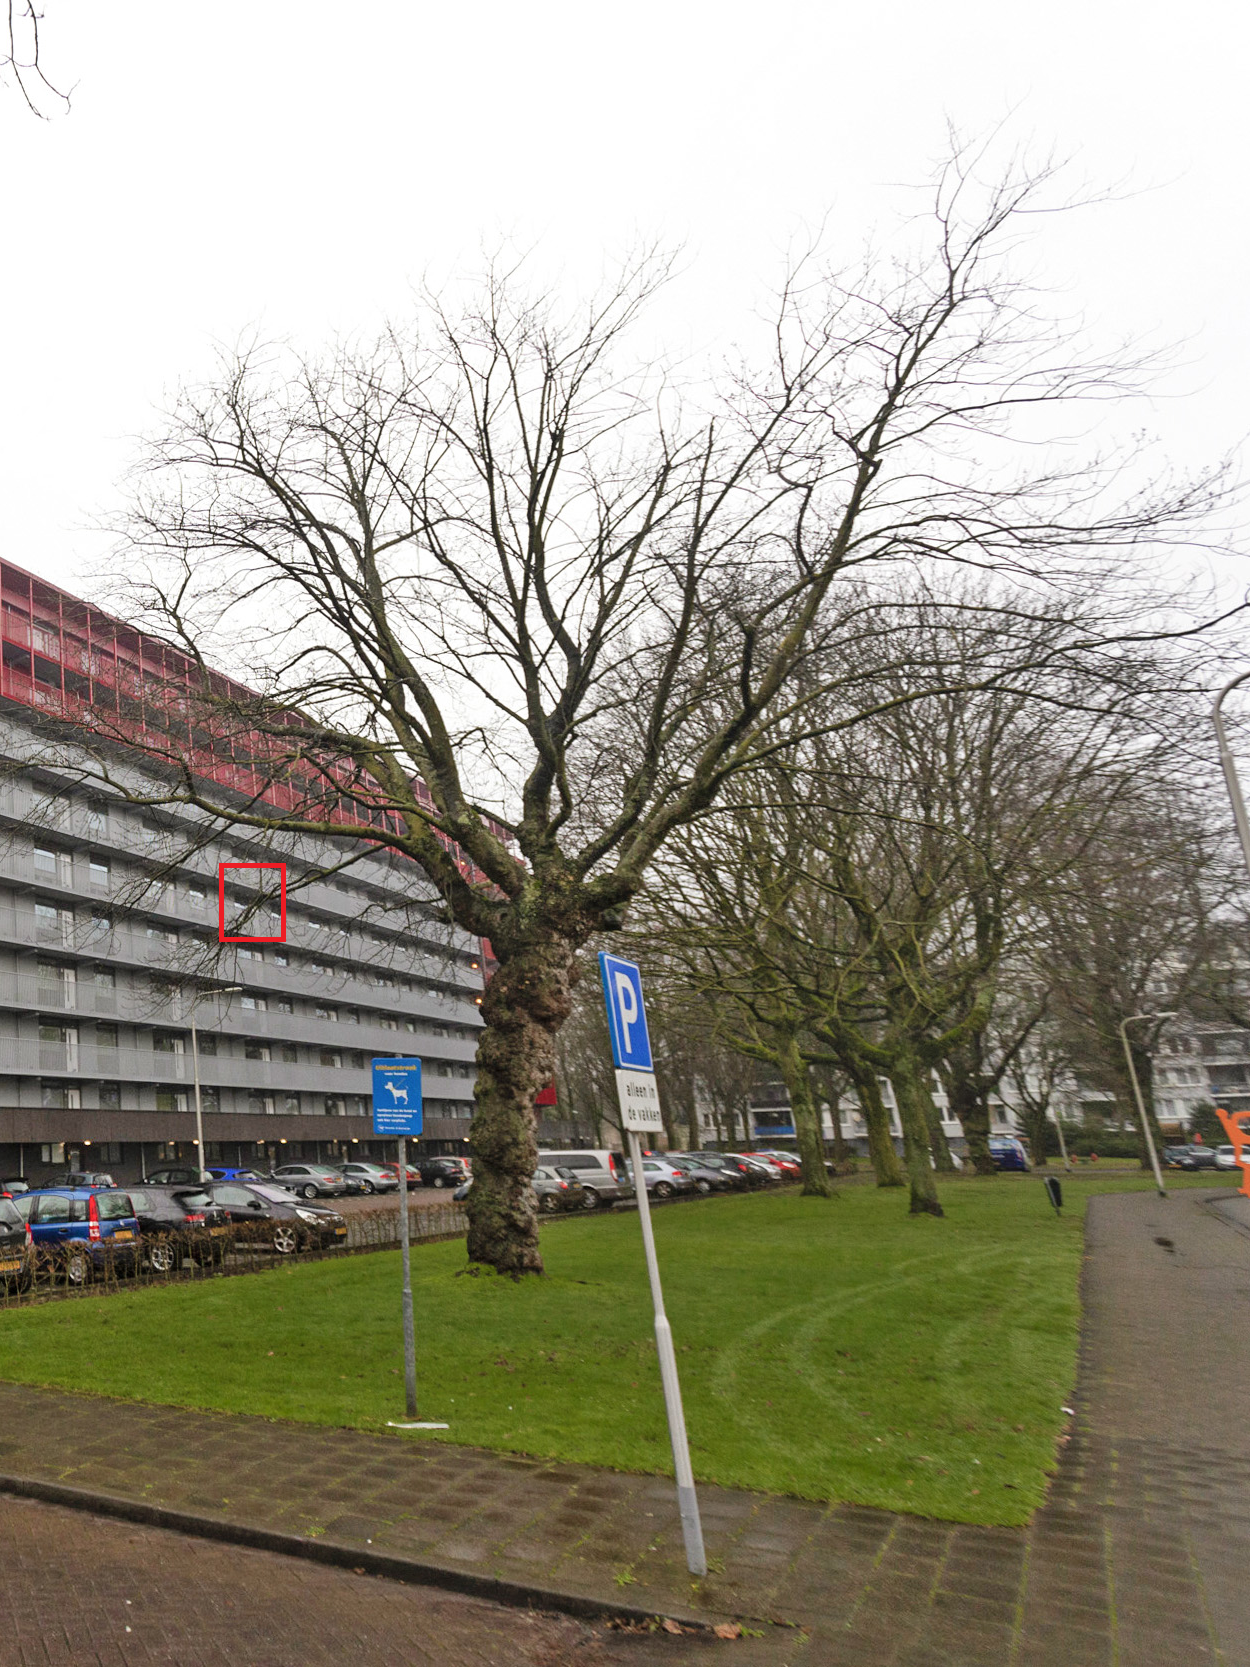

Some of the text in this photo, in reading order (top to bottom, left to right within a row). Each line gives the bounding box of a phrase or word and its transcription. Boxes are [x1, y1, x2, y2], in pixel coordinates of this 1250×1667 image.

[614, 970, 638, 1055] P
[626, 1081, 656, 1099] alleen in
[628, 1104, 661, 1122] de vakken
